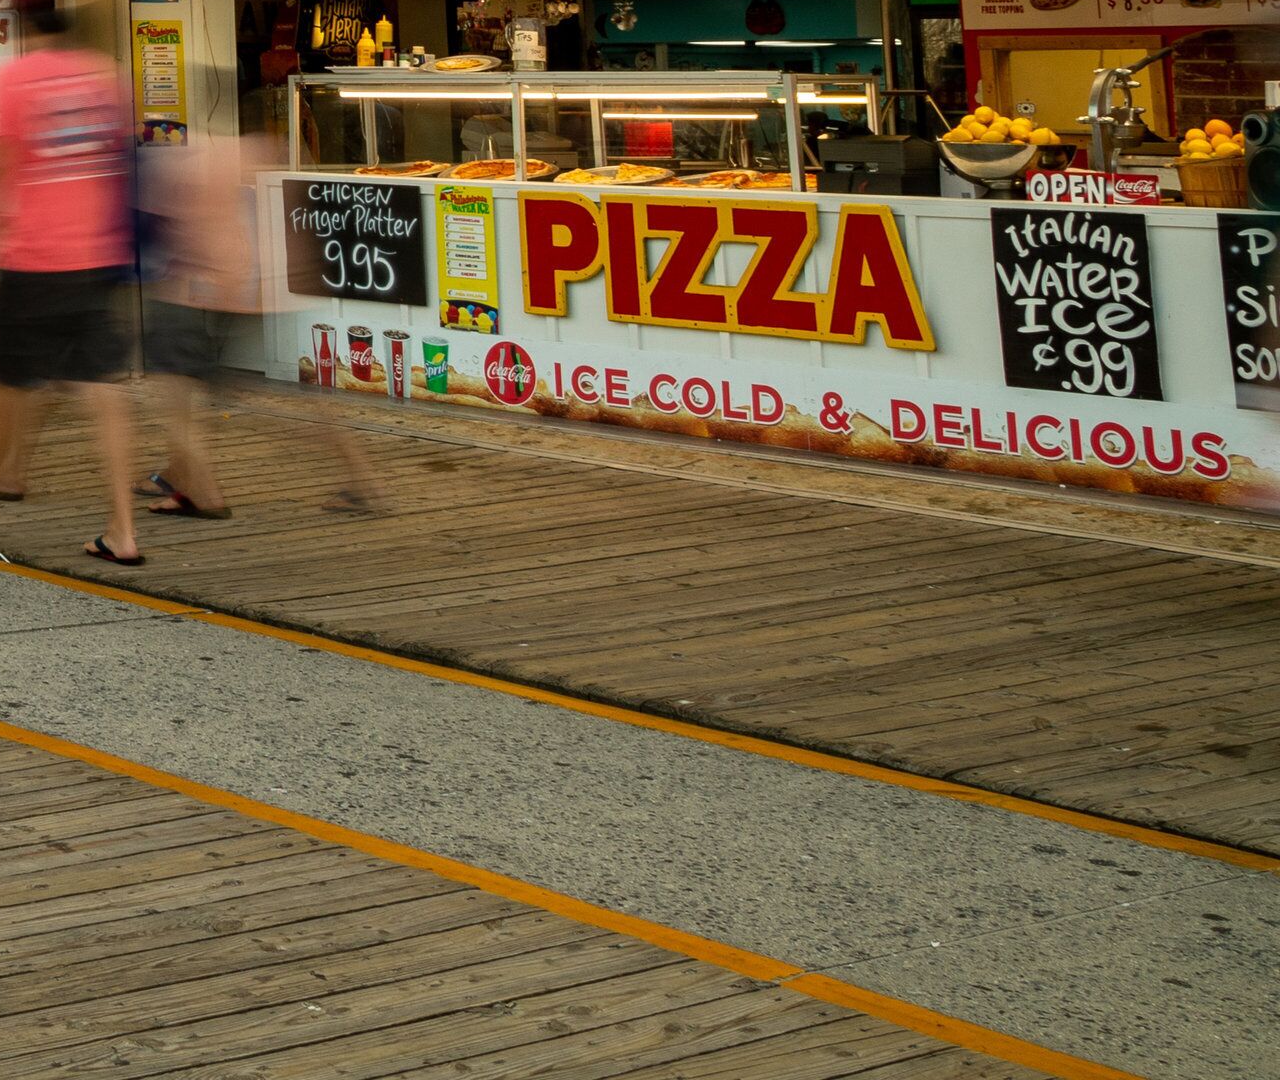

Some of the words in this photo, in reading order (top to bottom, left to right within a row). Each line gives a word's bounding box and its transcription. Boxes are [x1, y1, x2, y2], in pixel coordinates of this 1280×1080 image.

[981, 5, 997, 14] FREE
[998, 5, 1024, 14] TOPPING
[325, 17, 362, 46] HERO
[308, 184, 393, 206] CHICKEN
[450, 193, 487, 204] Philadelphia
[1030, 173, 1105, 205] OPEN
[1115, 179, 1156, 194] Coca-Cola
[289, 207, 352, 239] Finger
[353, 206, 418, 238] Platter
[451, 204, 477, 214] WATER
[477, 204, 490, 214] ICE
[321, 239, 398, 292] 9.95
[518, 191, 936, 352] PIZZA
[1014, 297, 1149, 339] Ice
[486, 362, 532, 384] Coca-Cola
[553, 362, 632, 408] ICE
[648, 372, 786, 425] COLD
[818, 390, 852, 435] &
[889, 398, 1231, 481] DELICIOUS
